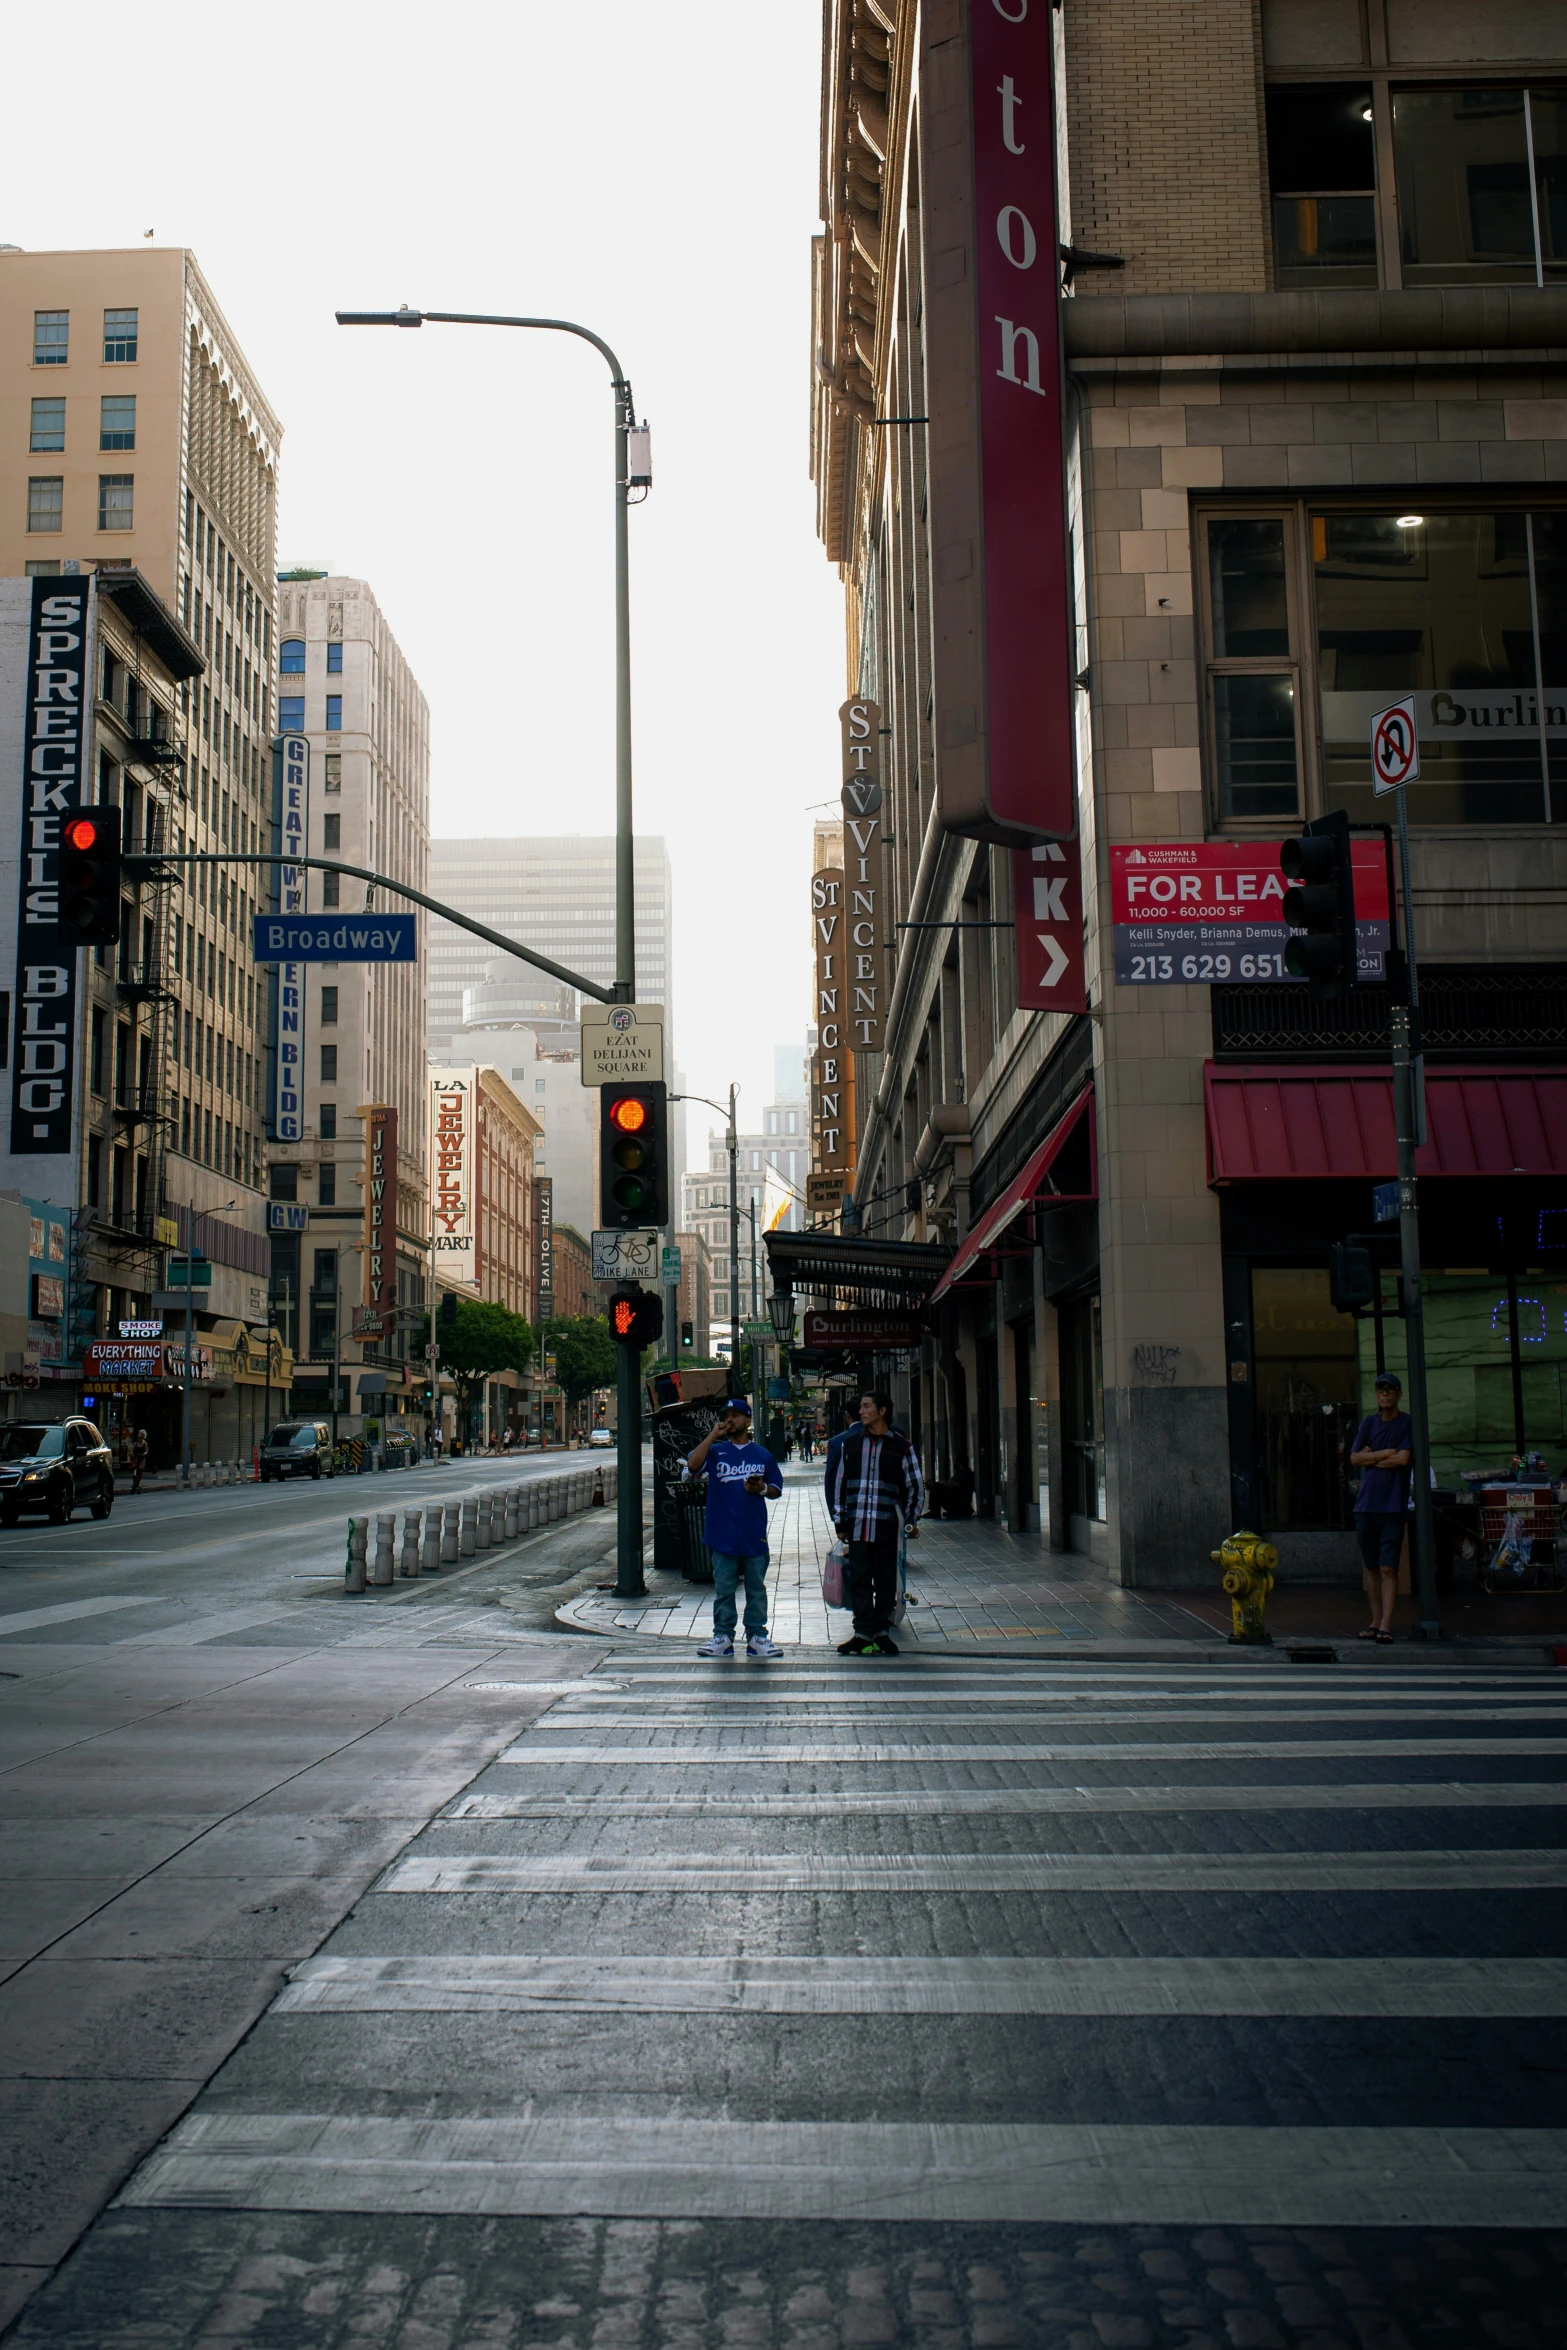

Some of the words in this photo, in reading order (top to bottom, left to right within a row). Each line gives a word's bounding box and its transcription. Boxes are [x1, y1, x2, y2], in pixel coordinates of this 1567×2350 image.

[849, 704, 873, 771] ST
[25, 595, 82, 925] SPRECKELS
[285, 740, 305, 857] GREAT
[1148, 850, 1189, 858] CUSHMAN
[812, 878, 840, 911] ST
[1126, 875, 1203, 903] FOR
[1128, 906, 1168, 919] 11,000
[1179, 905, 1226, 918] 60,000
[1228, 905, 1245, 917] SF
[268, 925, 402, 955] Broadway
[846, 819, 879, 1046] VINCENT
[1129, 928, 1154, 940] Kelli
[1156, 927, 1197, 943] Snyder,
[1200, 927, 1243, 939] Brianna
[1246, 927, 1286, 940] Demus,
[1366, 925, 1381, 936] Jr.
[281, 864, 300, 1032] WERN
[1130, 955, 1173, 980] 213
[1181, 954, 1232, 979] 629
[605, 1035, 639, 1047] EZAT
[816, 915, 841, 1154] VINCENT
[18, 965, 69, 1139] BLDG.
[592, 1047, 652, 1061] DELIJANI
[596, 1060, 648, 1074] SQUARE
[280, 1049, 298, 1140] BLDG
[433, 1080, 468, 1092] LA
[435, 1094, 466, 1233] JEWELRY
[809, 1178, 845, 1194] JEWELRY
[814, 1191, 825, 1201] Est
[826, 1190, 841, 1200] 1983
[271, 1204, 307, 1229] GW
[370, 1129, 385, 1303] JEWELRY
[541, 1197, 550, 1225] 7TH
[428, 1235, 473, 1251] MART
[541, 1239, 550, 1287] OLIVE
[625, 1266, 650, 1276] LANE
[363, 1310, 377, 1320] (213)
[120, 1330, 161, 1338] SHOP
[811, 1315, 910, 1338] Burlington
[91, 1345, 161, 1359] EVERYTHING
[98, 1359, 156, 1376] MARKET
[82, 1383, 117, 1393] MOKE
[121, 1383, 154, 1393] SHOP
[715, 1460, 766, 1478] Dodgers
[1508, 1494, 1527, 1502] Only
